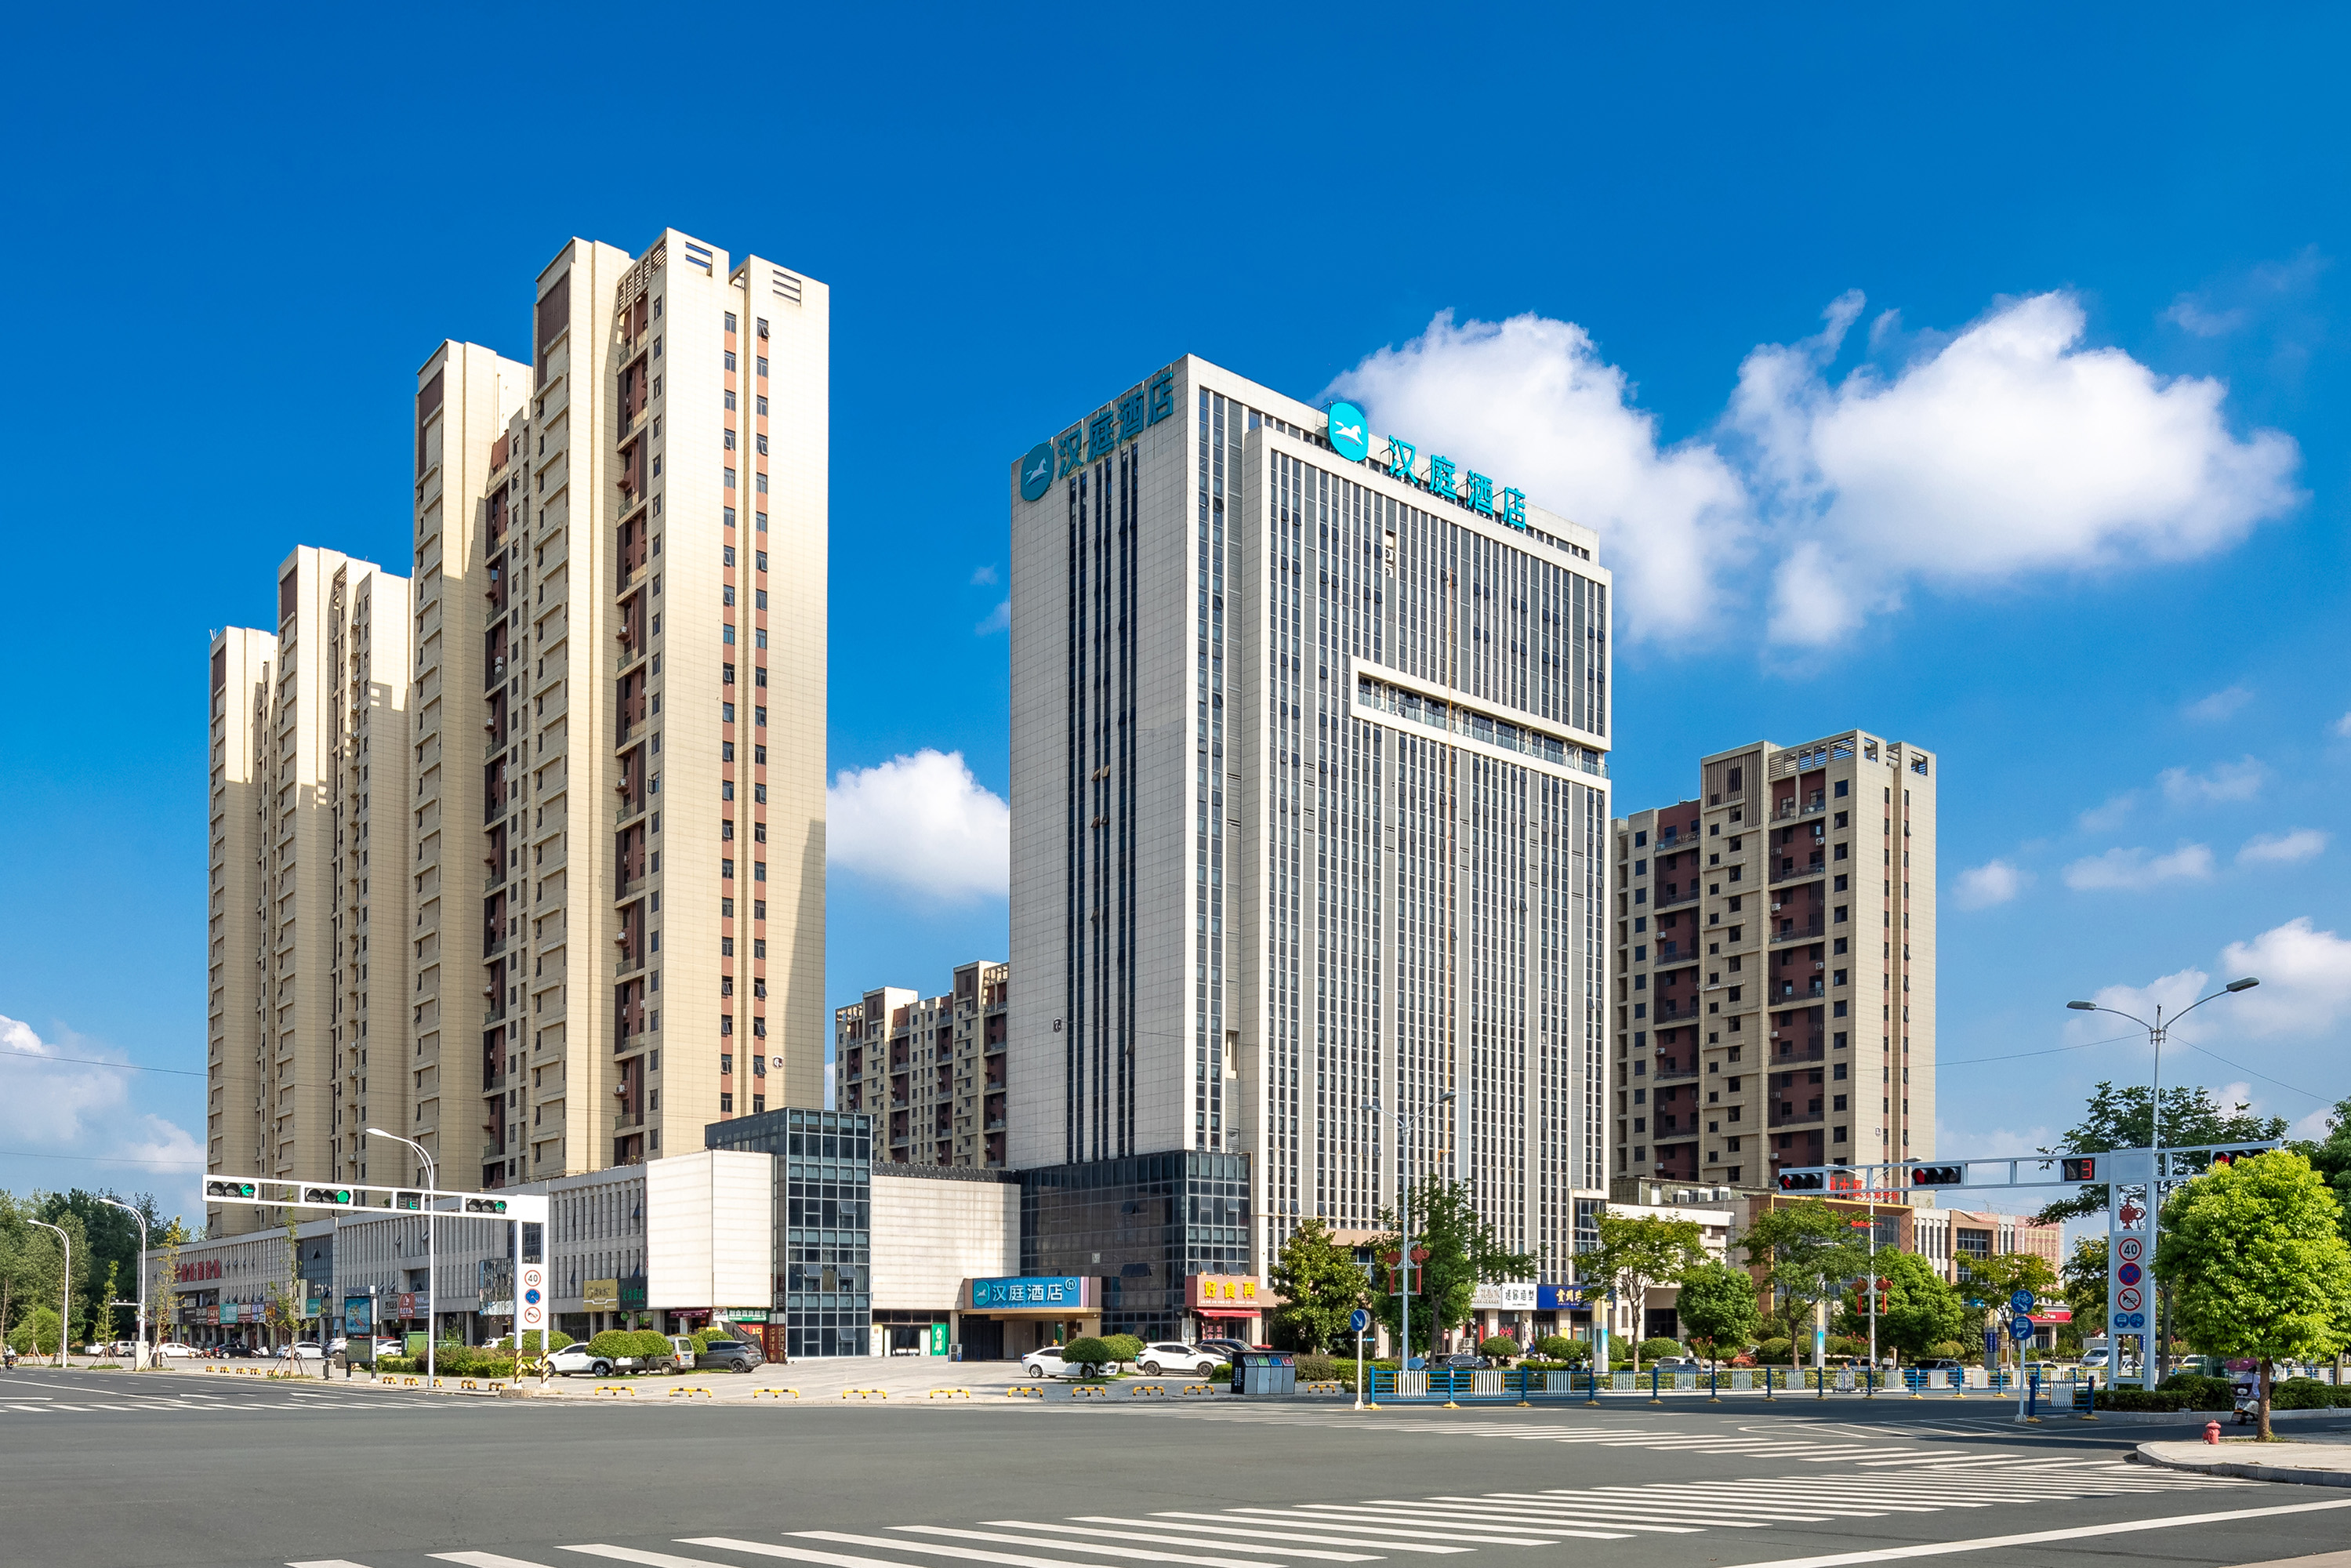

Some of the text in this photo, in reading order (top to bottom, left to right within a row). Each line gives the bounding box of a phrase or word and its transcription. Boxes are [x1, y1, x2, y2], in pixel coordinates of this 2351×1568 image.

[1058, 372, 1174, 480] 汉庭酒店
[1388, 435, 1526, 529] 汉庭酒店
[2124, 1244, 2138, 1255] 40
[528, 1274, 539, 1283] 40
[992, 1283, 1063, 1302] 汉庭酒店
[1204, 1281, 1255, 1299] 好食再
